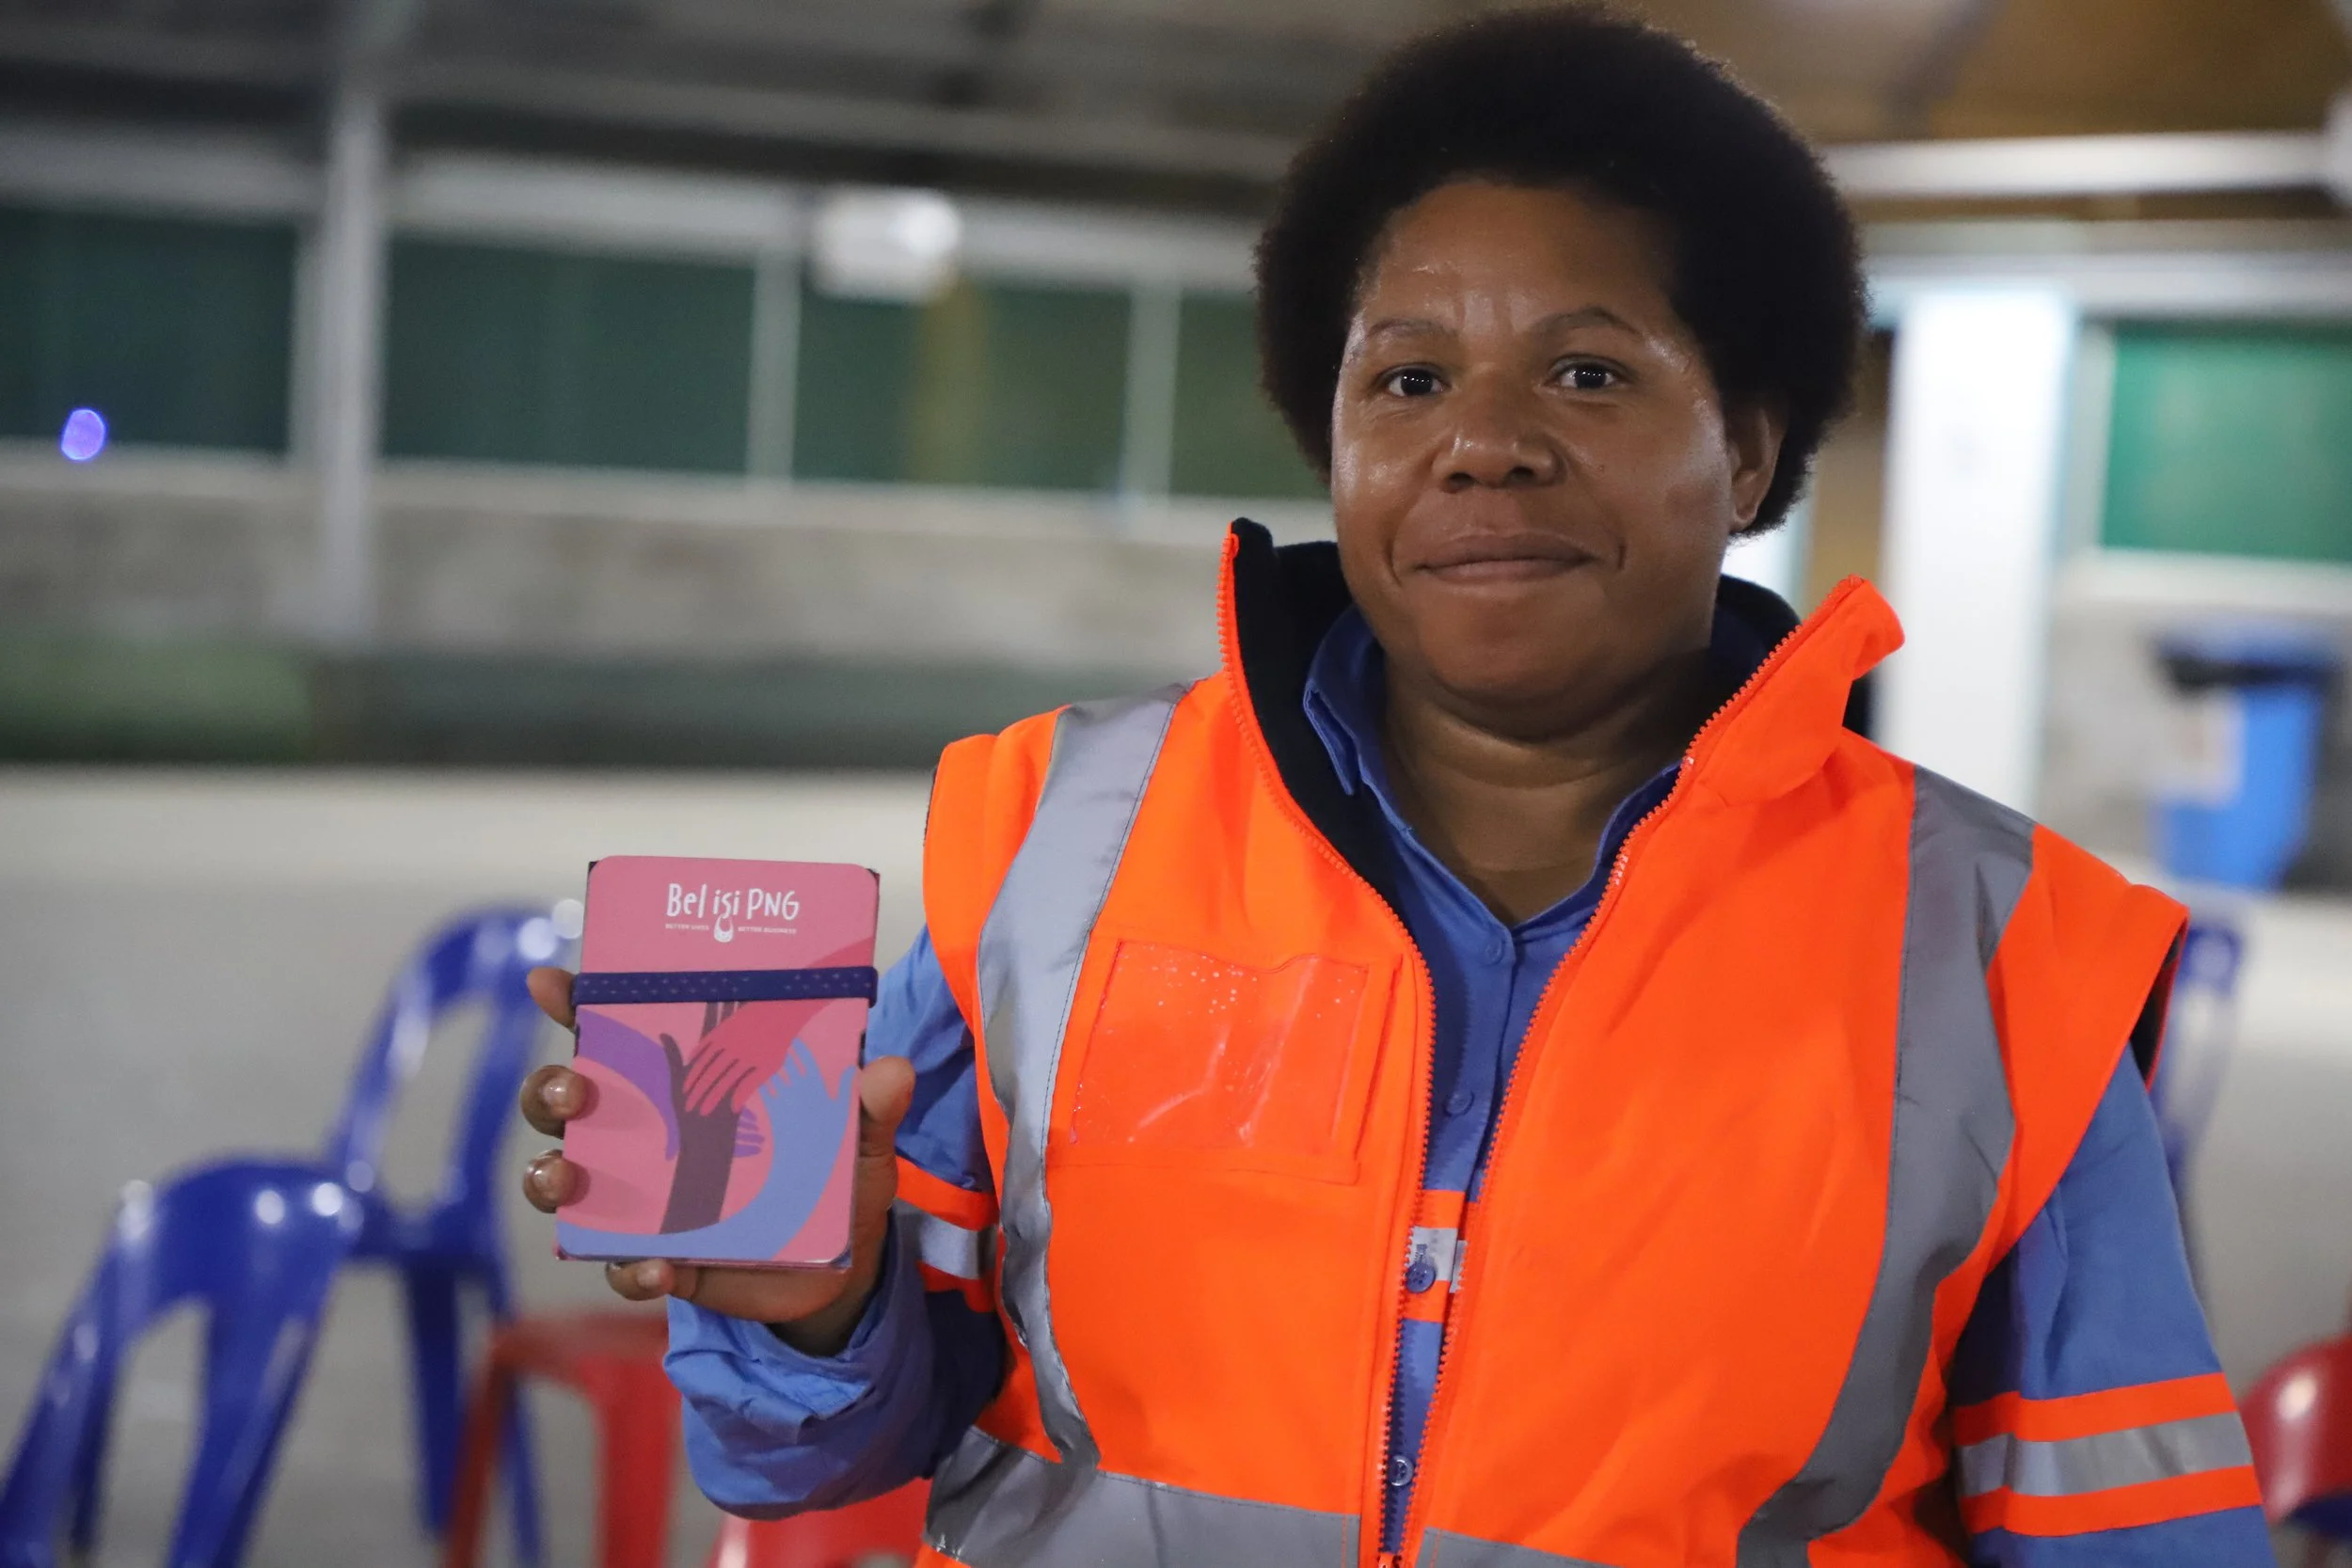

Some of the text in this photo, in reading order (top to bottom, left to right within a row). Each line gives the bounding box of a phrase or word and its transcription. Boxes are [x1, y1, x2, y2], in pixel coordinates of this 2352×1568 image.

[666, 882, 800, 921] Bel isi PNG
